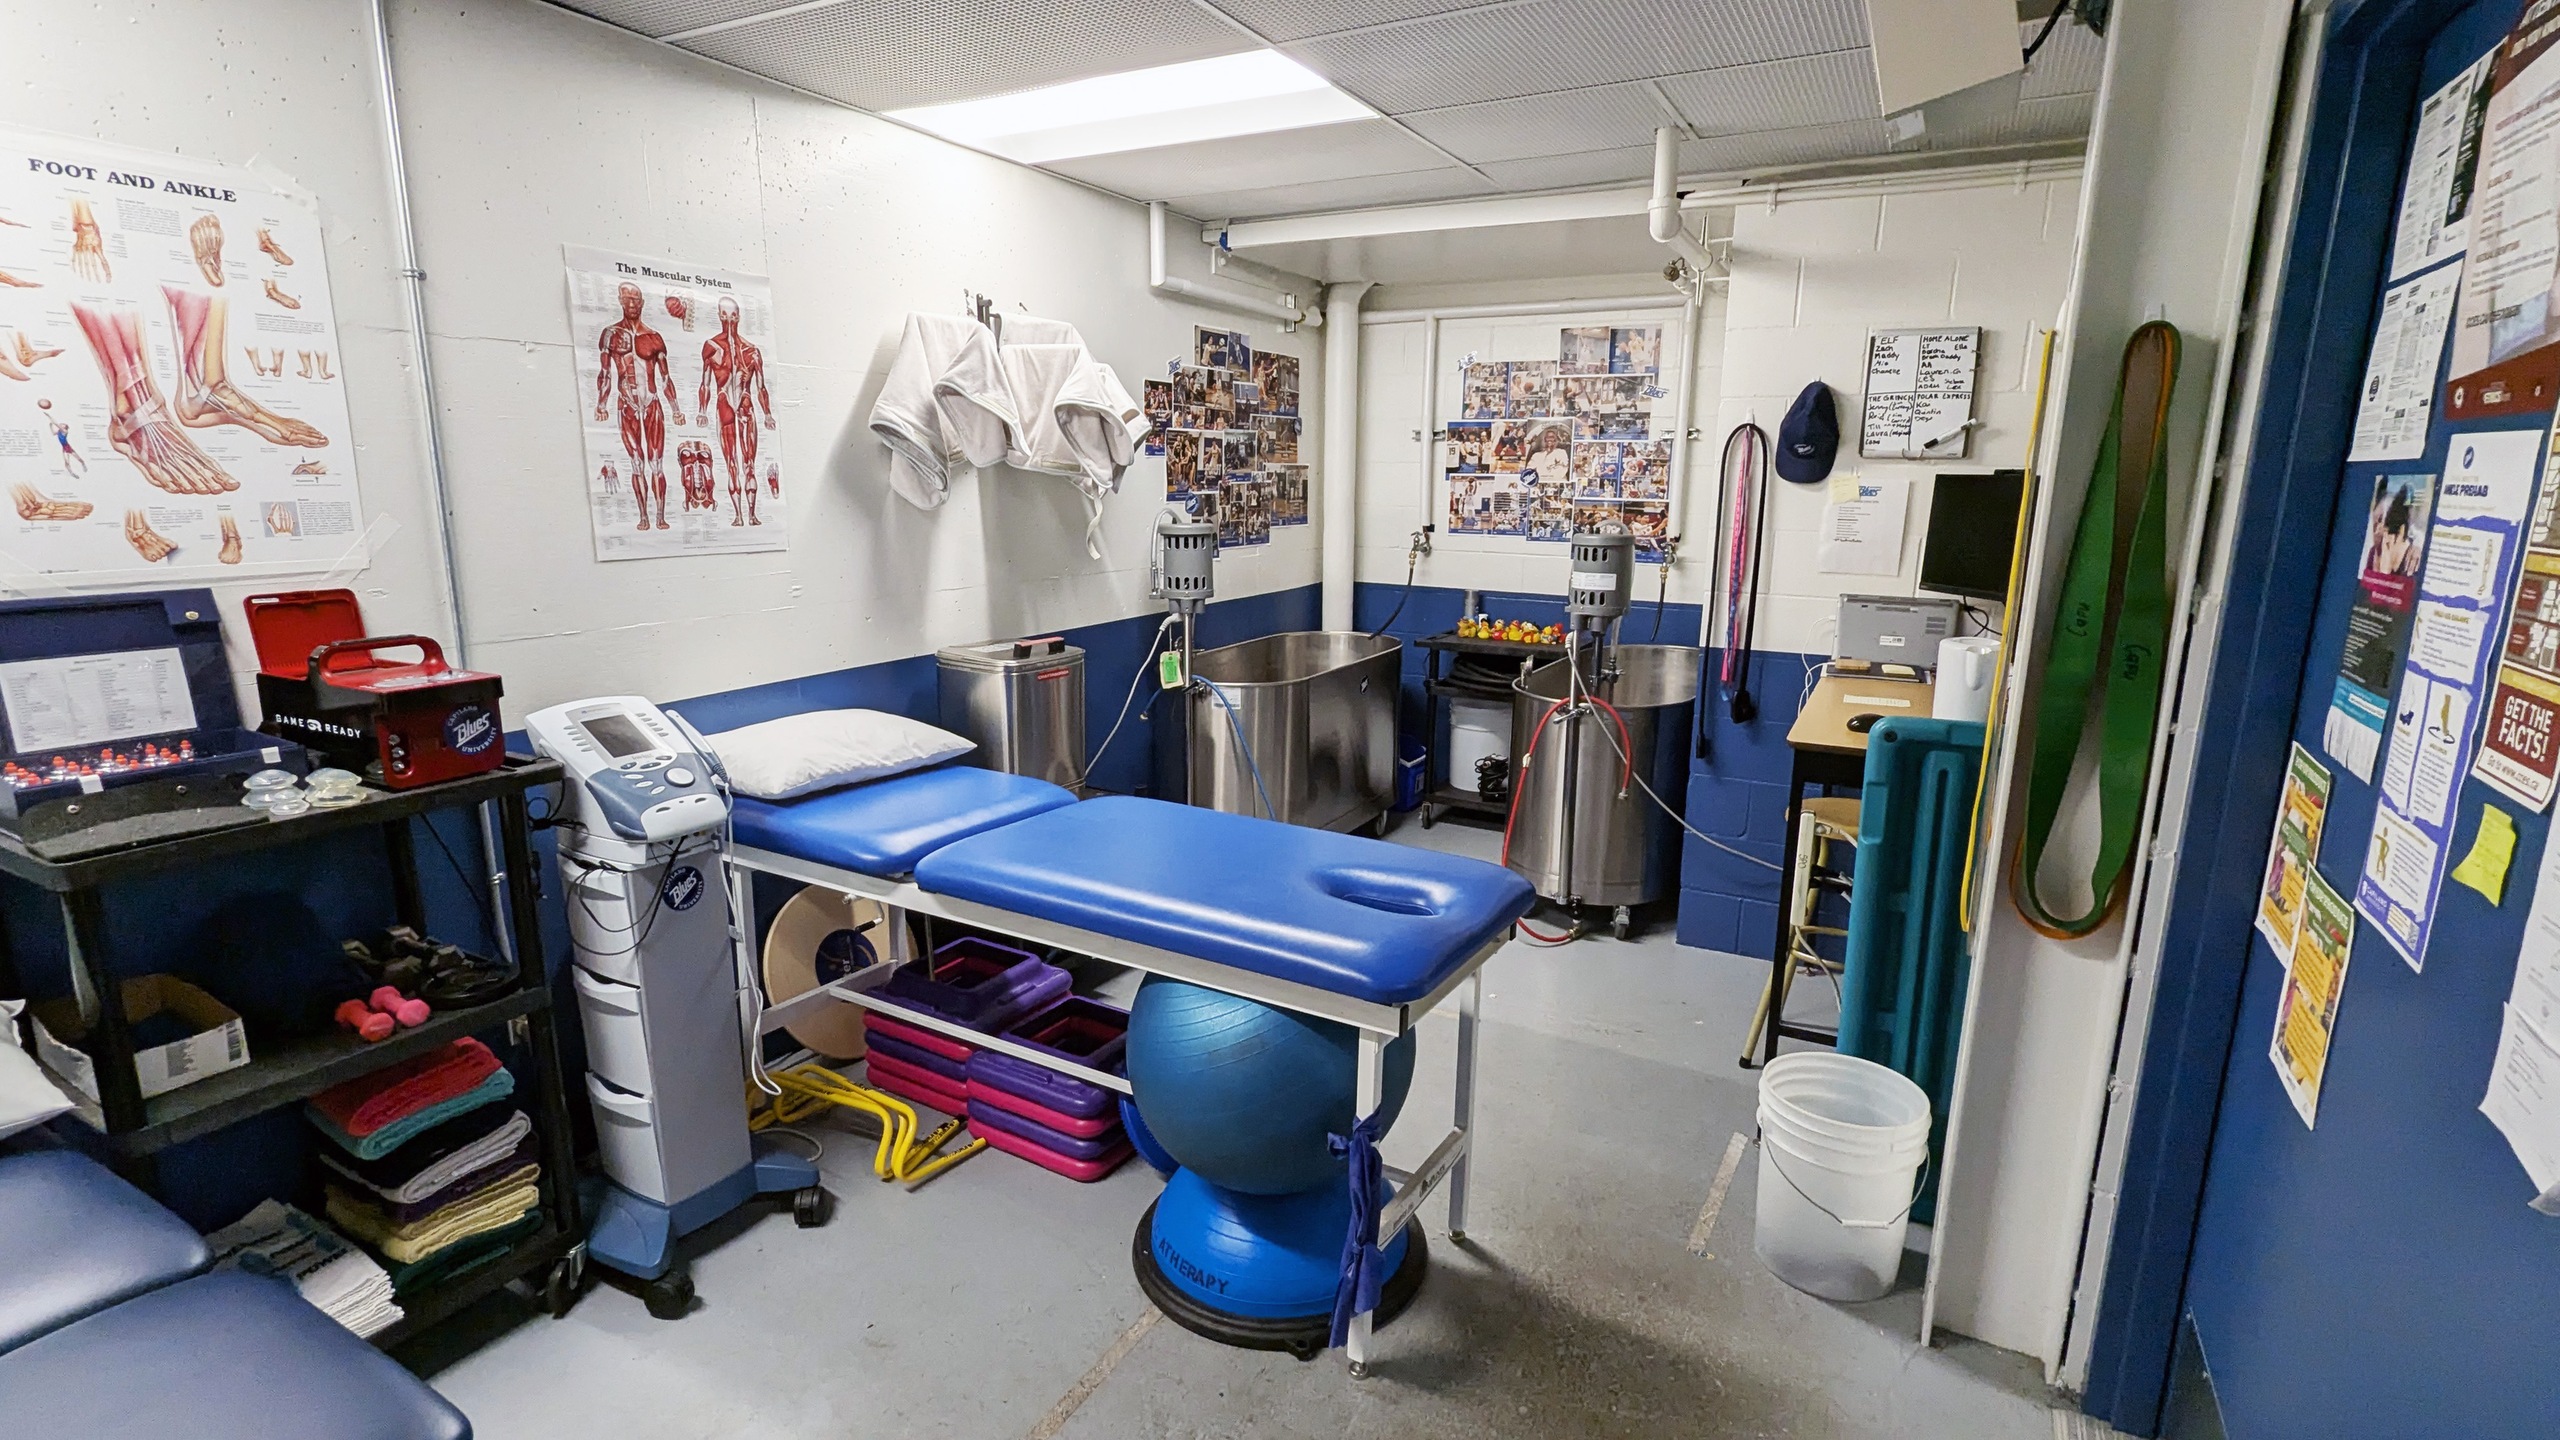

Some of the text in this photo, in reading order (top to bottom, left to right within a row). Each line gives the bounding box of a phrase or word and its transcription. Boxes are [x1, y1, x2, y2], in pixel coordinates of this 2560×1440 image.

[28, 157, 237, 203] FOOT AND ANKLE
[615, 262, 732, 289] The Muscular System
[1880, 336, 1899, 345] ELF
[1923, 335, 1942, 343] HOME
[1874, 352, 1900, 361] Maddy
[275, 714, 305, 727] GAME
[325, 723, 361, 738] READY
[453, 712, 490, 748] Blues
[2505, 695, 2554, 734] GET THE
[462, 727, 497, 752] UNIVERSITY
[2498, 717, 2550, 762] FACTS!
[669, 870, 697, 908] Blues
[1159, 1237, 1228, 1294] ATHERAPY
